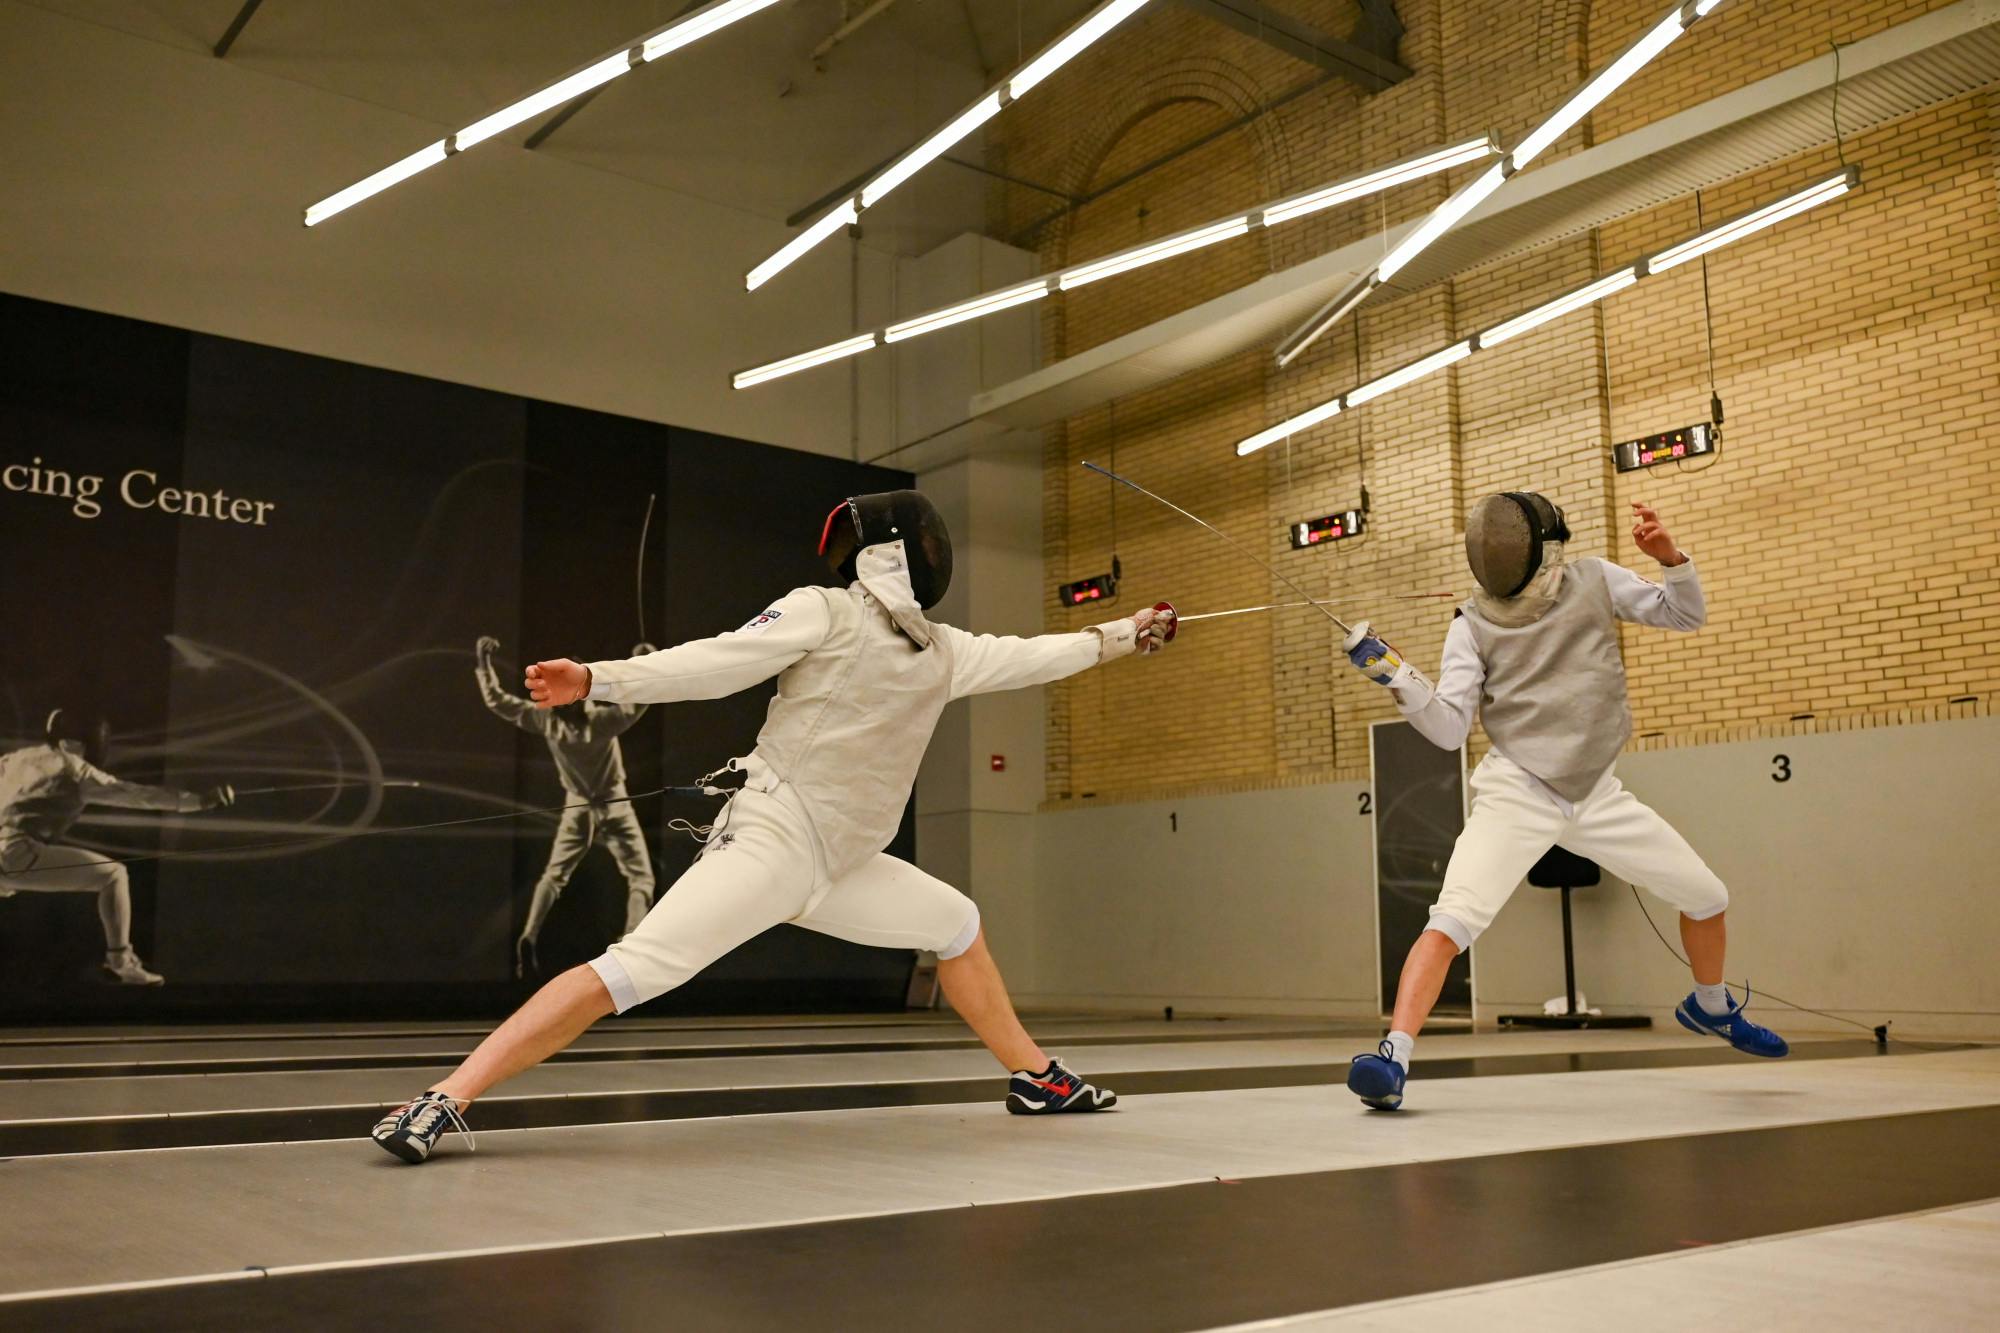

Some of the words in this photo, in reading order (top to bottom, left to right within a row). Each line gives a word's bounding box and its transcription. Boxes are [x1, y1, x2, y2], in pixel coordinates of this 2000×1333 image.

[2, 456, 103, 519] cing
[120, 469, 275, 526] Center
[1771, 754, 1792, 783] 3
[1358, 792, 1372, 815] 2
[1169, 811, 1177, 832] 1
